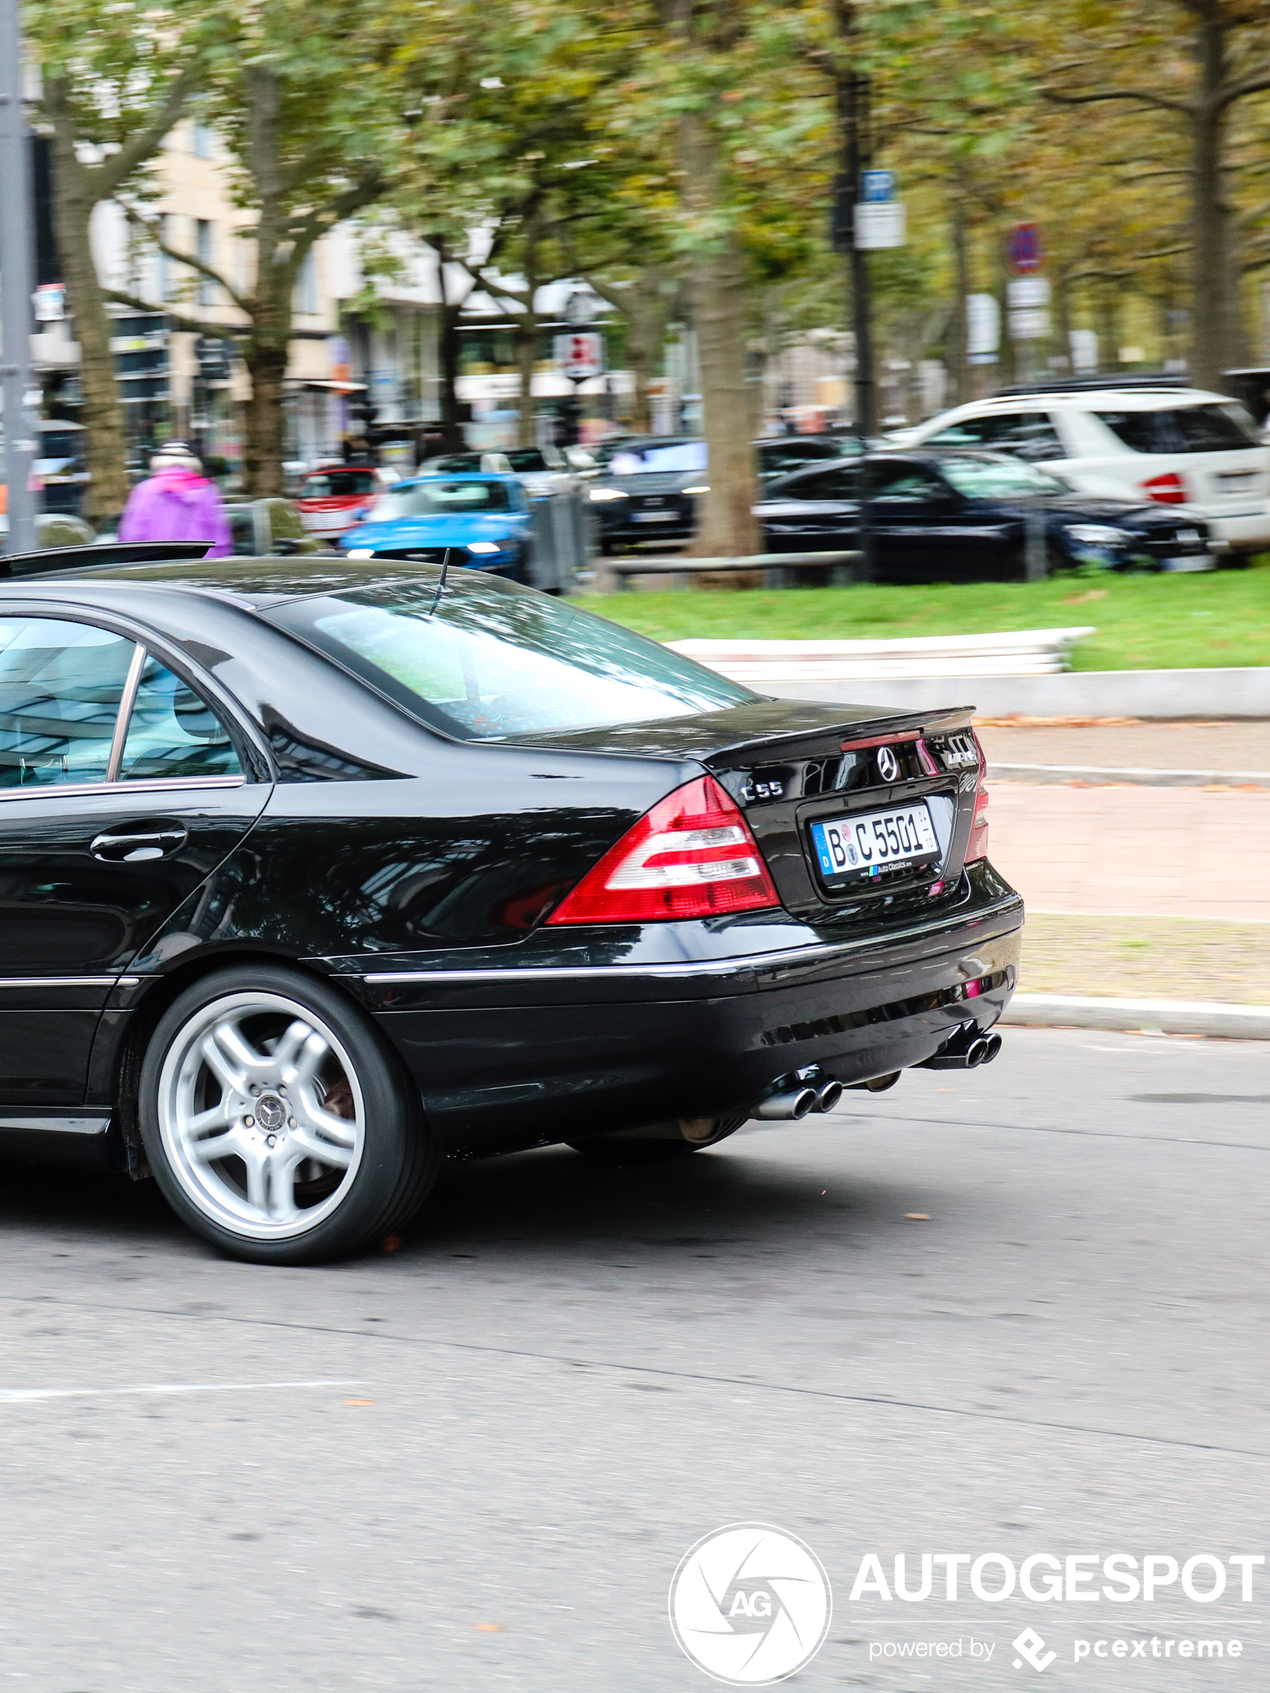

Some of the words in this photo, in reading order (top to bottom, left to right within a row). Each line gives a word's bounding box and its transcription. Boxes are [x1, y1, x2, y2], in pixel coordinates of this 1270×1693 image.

[828, 828, 846, 868] B
[855, 823, 873, 861] C
[871, 813, 924, 858] 5501
[822, 855, 830, 868] D
